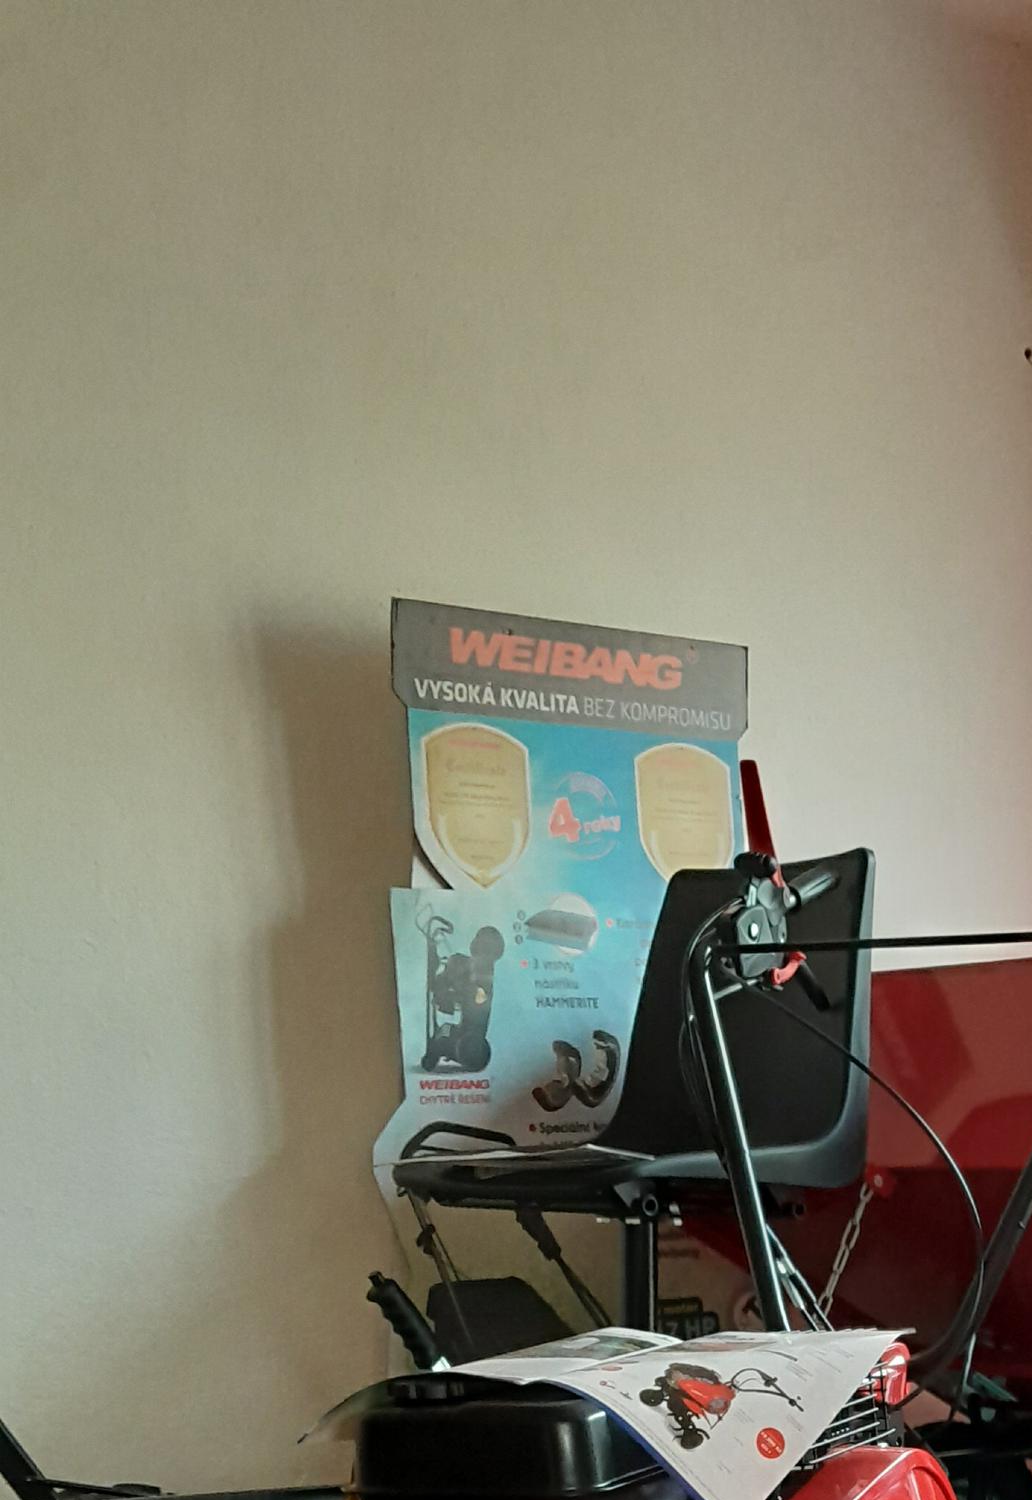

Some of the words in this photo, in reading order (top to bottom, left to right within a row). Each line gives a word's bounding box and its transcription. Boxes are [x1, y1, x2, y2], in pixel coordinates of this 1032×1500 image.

[448, 626, 683, 690] WEIBANG
[413, 677, 496, 706] VYSOKÁ
[500, 687, 580, 715] KVALITA
[584, 696, 615, 719] BEZ
[620, 701, 731, 731] KOMPROMISU
[548, 797, 580, 843] 4
[419, 1078, 490, 1090] WEIBANG
